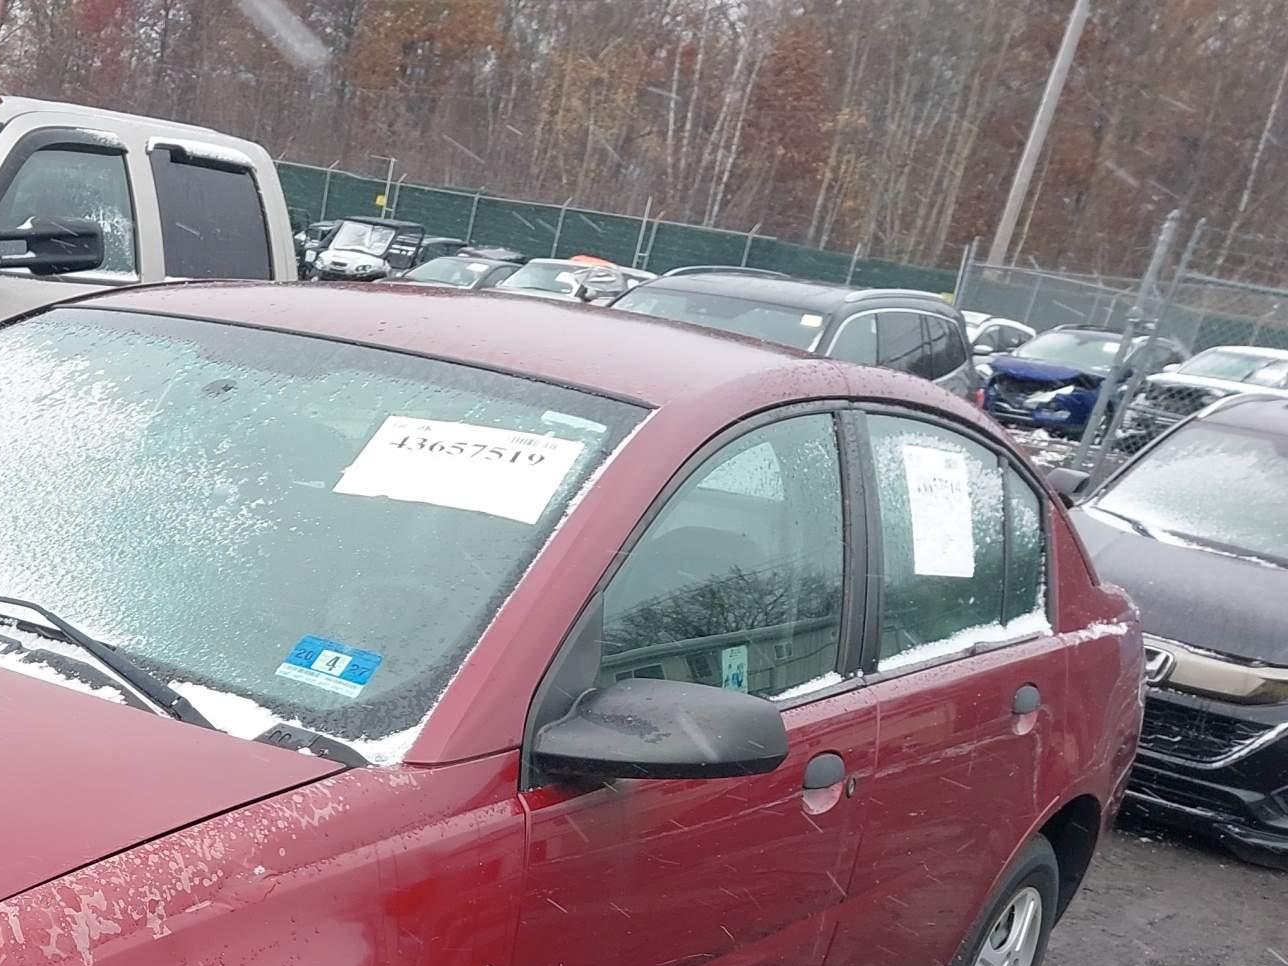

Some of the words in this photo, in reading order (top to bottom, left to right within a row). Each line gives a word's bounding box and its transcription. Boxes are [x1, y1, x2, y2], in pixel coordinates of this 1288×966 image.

[389, 435, 545, 466] 43657519
[295, 648, 313, 661] 20
[325, 655, 341, 672] 4
[351, 663, 369, 677] 27
